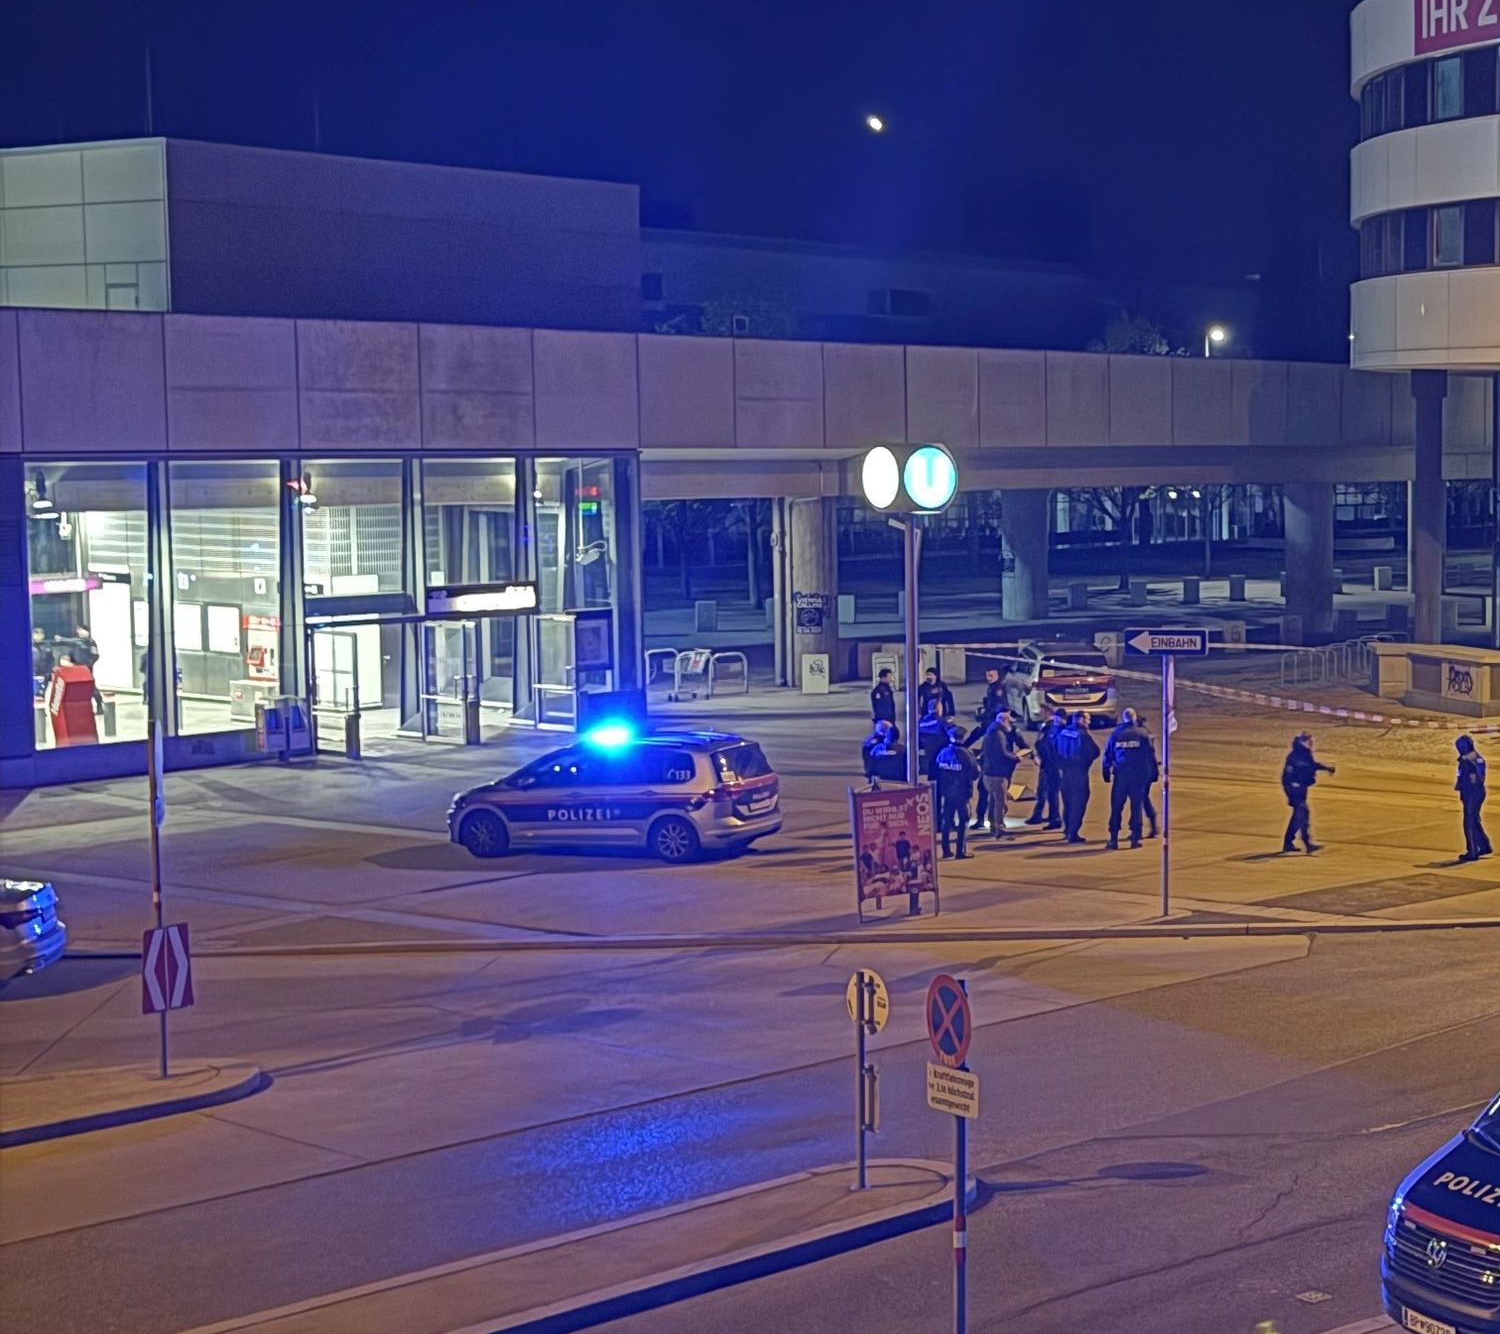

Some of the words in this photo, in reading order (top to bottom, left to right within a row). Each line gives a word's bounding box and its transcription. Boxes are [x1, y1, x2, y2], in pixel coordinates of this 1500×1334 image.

[913, 455, 951, 504] U
[1150, 637, 1198, 648] EINBAHN
[675, 770, 691, 781] 133
[547, 808, 612, 821] POLIZEI
[915, 793, 931, 836] NEOS
